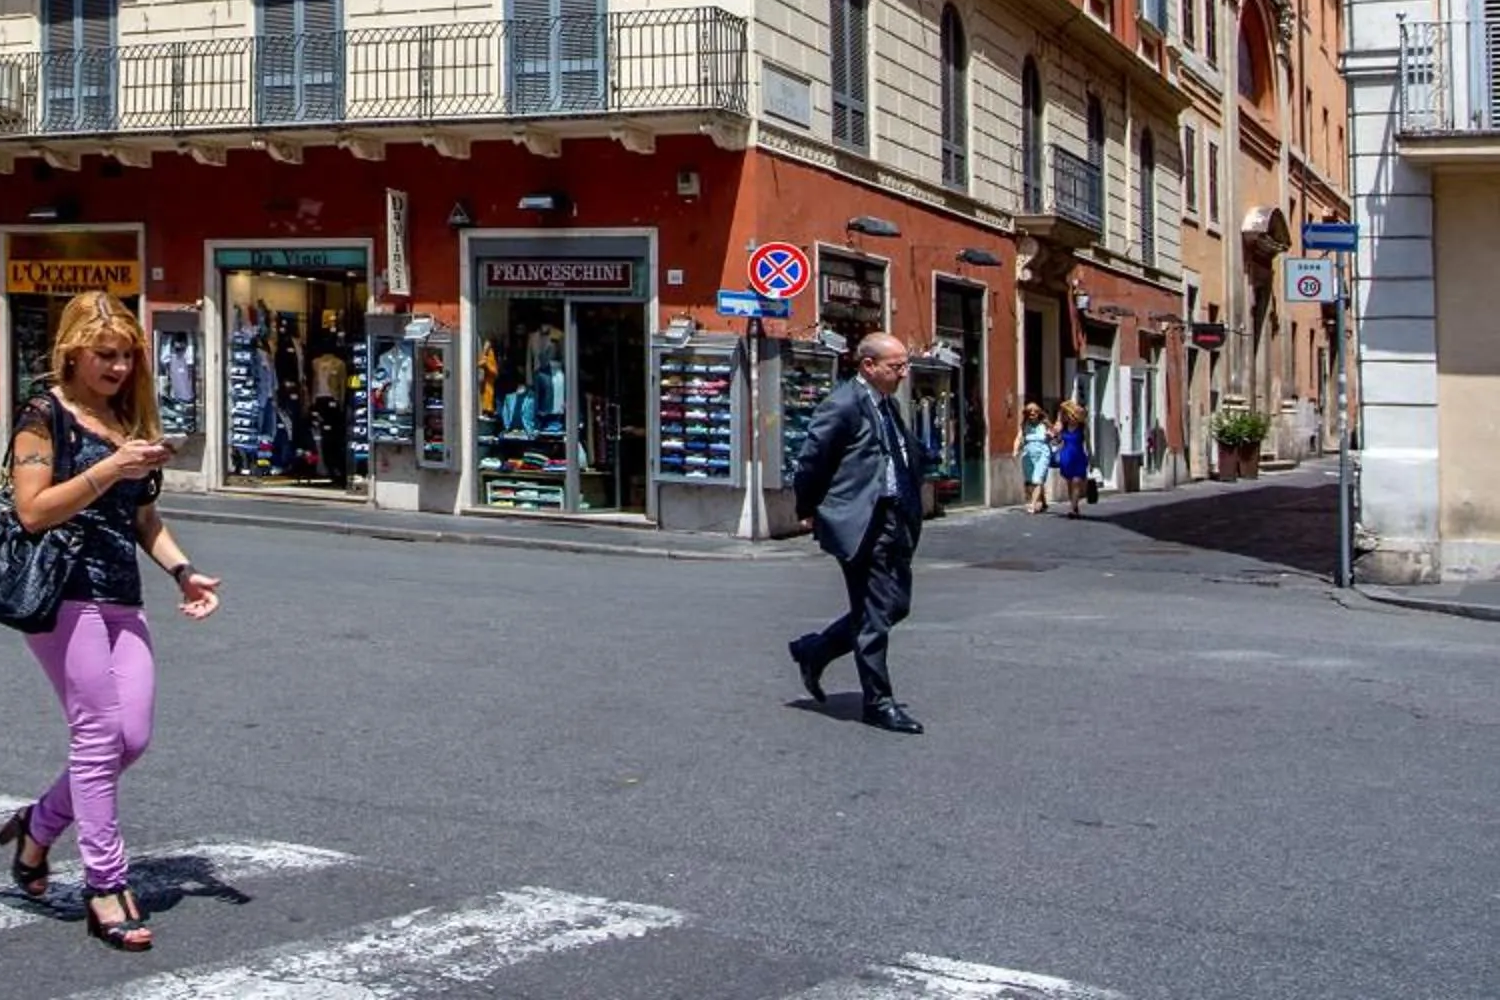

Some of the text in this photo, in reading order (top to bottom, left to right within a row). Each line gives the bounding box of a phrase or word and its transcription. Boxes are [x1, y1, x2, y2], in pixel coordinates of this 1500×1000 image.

[284, 248, 328, 265] Vinci
[13, 261, 132, 283] L'OCCITANE
[492, 263, 624, 281] FRANCESCHINI
